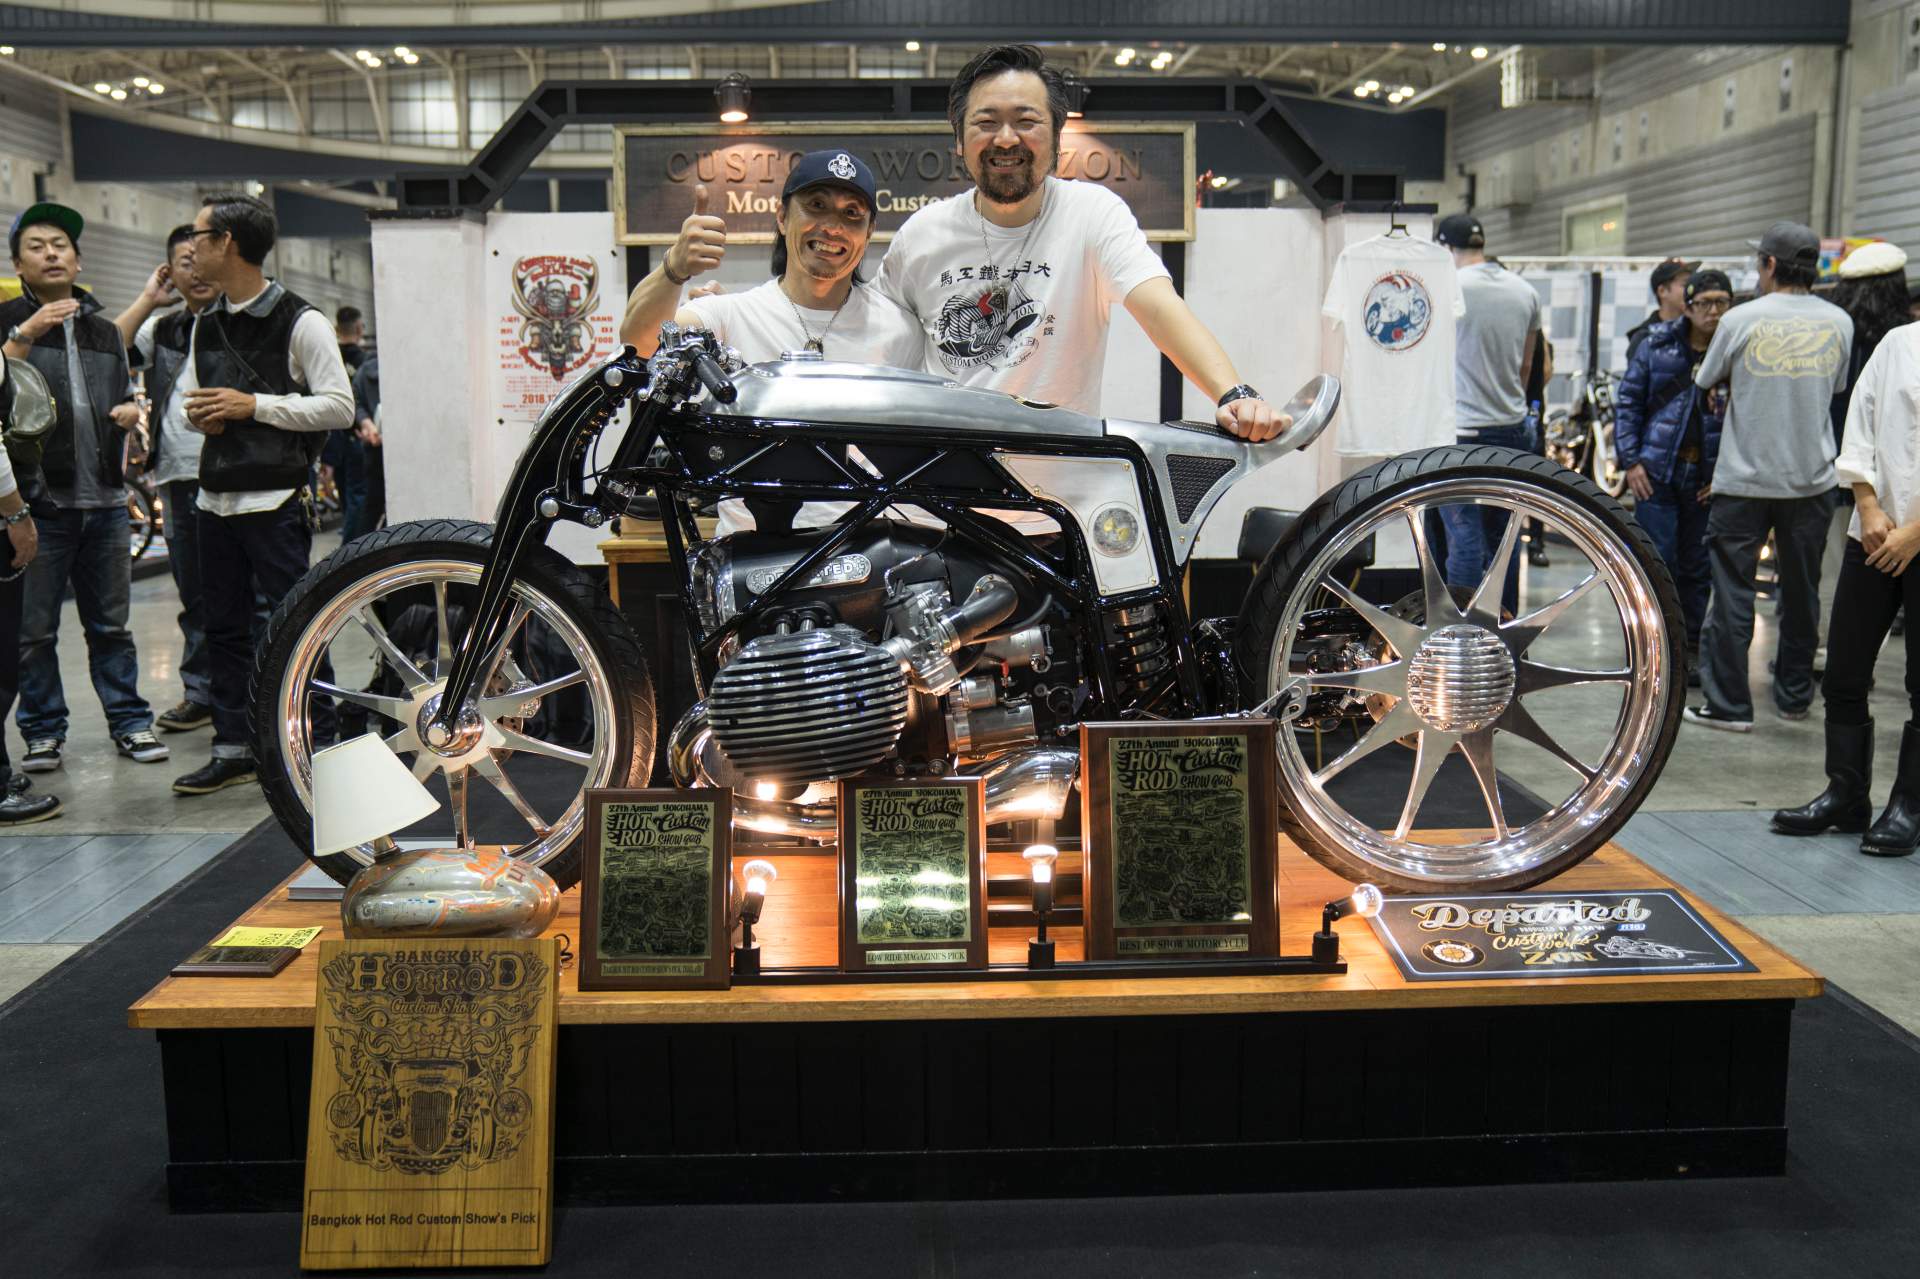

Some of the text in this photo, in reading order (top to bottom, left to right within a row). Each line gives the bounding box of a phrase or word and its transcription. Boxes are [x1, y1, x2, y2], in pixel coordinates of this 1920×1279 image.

[1056, 148, 1143, 181] ZON
[1014, 303, 1036, 320] ZON
[941, 352, 971, 368] CUSTOM
[973, 343, 1006, 366] WORKS
[1118, 737, 1240, 749] 27th Annual YOKOHAMA
[1128, 748, 1241, 773] HOT Custom
[1132, 769, 1178, 791] ROD
[1181, 775, 1211, 789] SHOW
[916, 788, 962, 797] YOKOHAMA
[609, 804, 629, 812] 27th
[663, 804, 709, 812] YOKOHAMA
[870, 798, 906, 815] HOT
[616, 813, 653, 830] HOT
[874, 814, 911, 832] ROD
[619, 829, 657, 846] ROD
[1411, 897, 1652, 935] Departed
[1492, 931, 1566, 950] Custom
[395, 950, 485, 963] BANGKOK
[867, 953, 883, 962] LOW
[884, 952, 903, 962] RIDE
[947, 951, 965, 960] PICK
[391, 996, 480, 1015] Custom Show
[311, 1212, 536, 1227] Bangkok Hot Rod Custom Show's Pick
